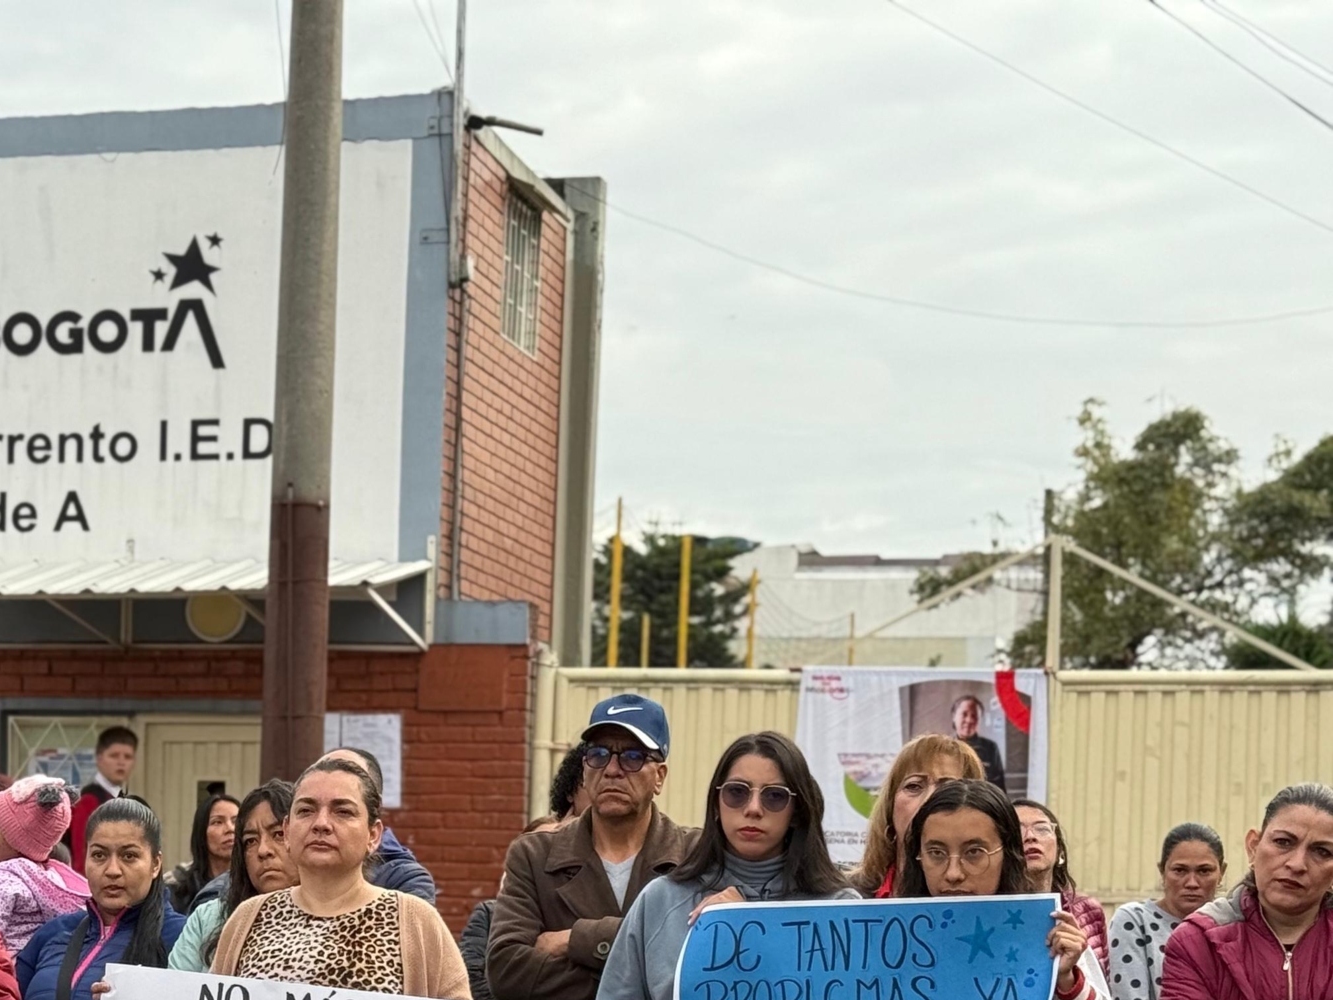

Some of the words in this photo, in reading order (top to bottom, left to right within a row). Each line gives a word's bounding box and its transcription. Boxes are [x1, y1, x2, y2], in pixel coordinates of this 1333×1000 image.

[53, 490, 90, 532] A
[702, 920, 766, 973] DE
[781, 914, 936, 973] TANTOS
